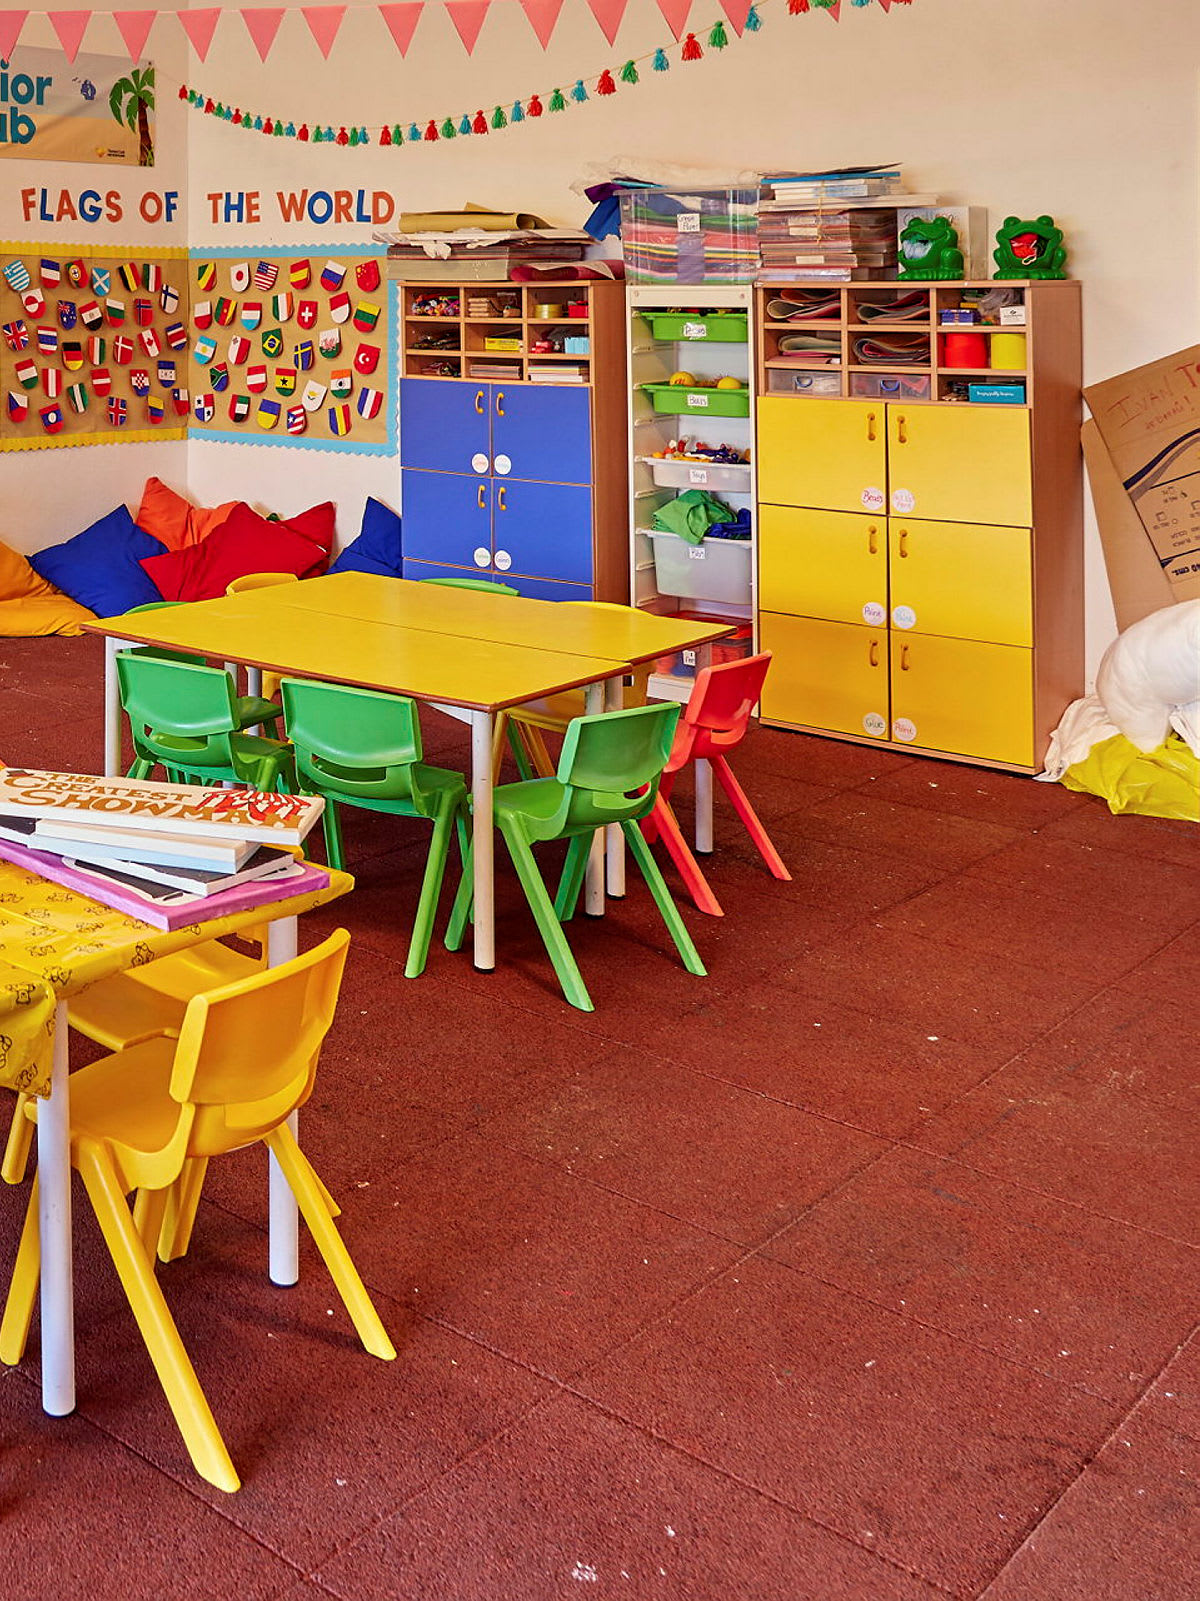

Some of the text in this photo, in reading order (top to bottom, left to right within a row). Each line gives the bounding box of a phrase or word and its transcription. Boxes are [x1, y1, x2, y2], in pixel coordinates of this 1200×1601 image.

[21, 188, 395, 225] FLAGS OF THE WORLD
[3, 774, 192, 801] GREATEST
[44, 772, 99, 785] THE
